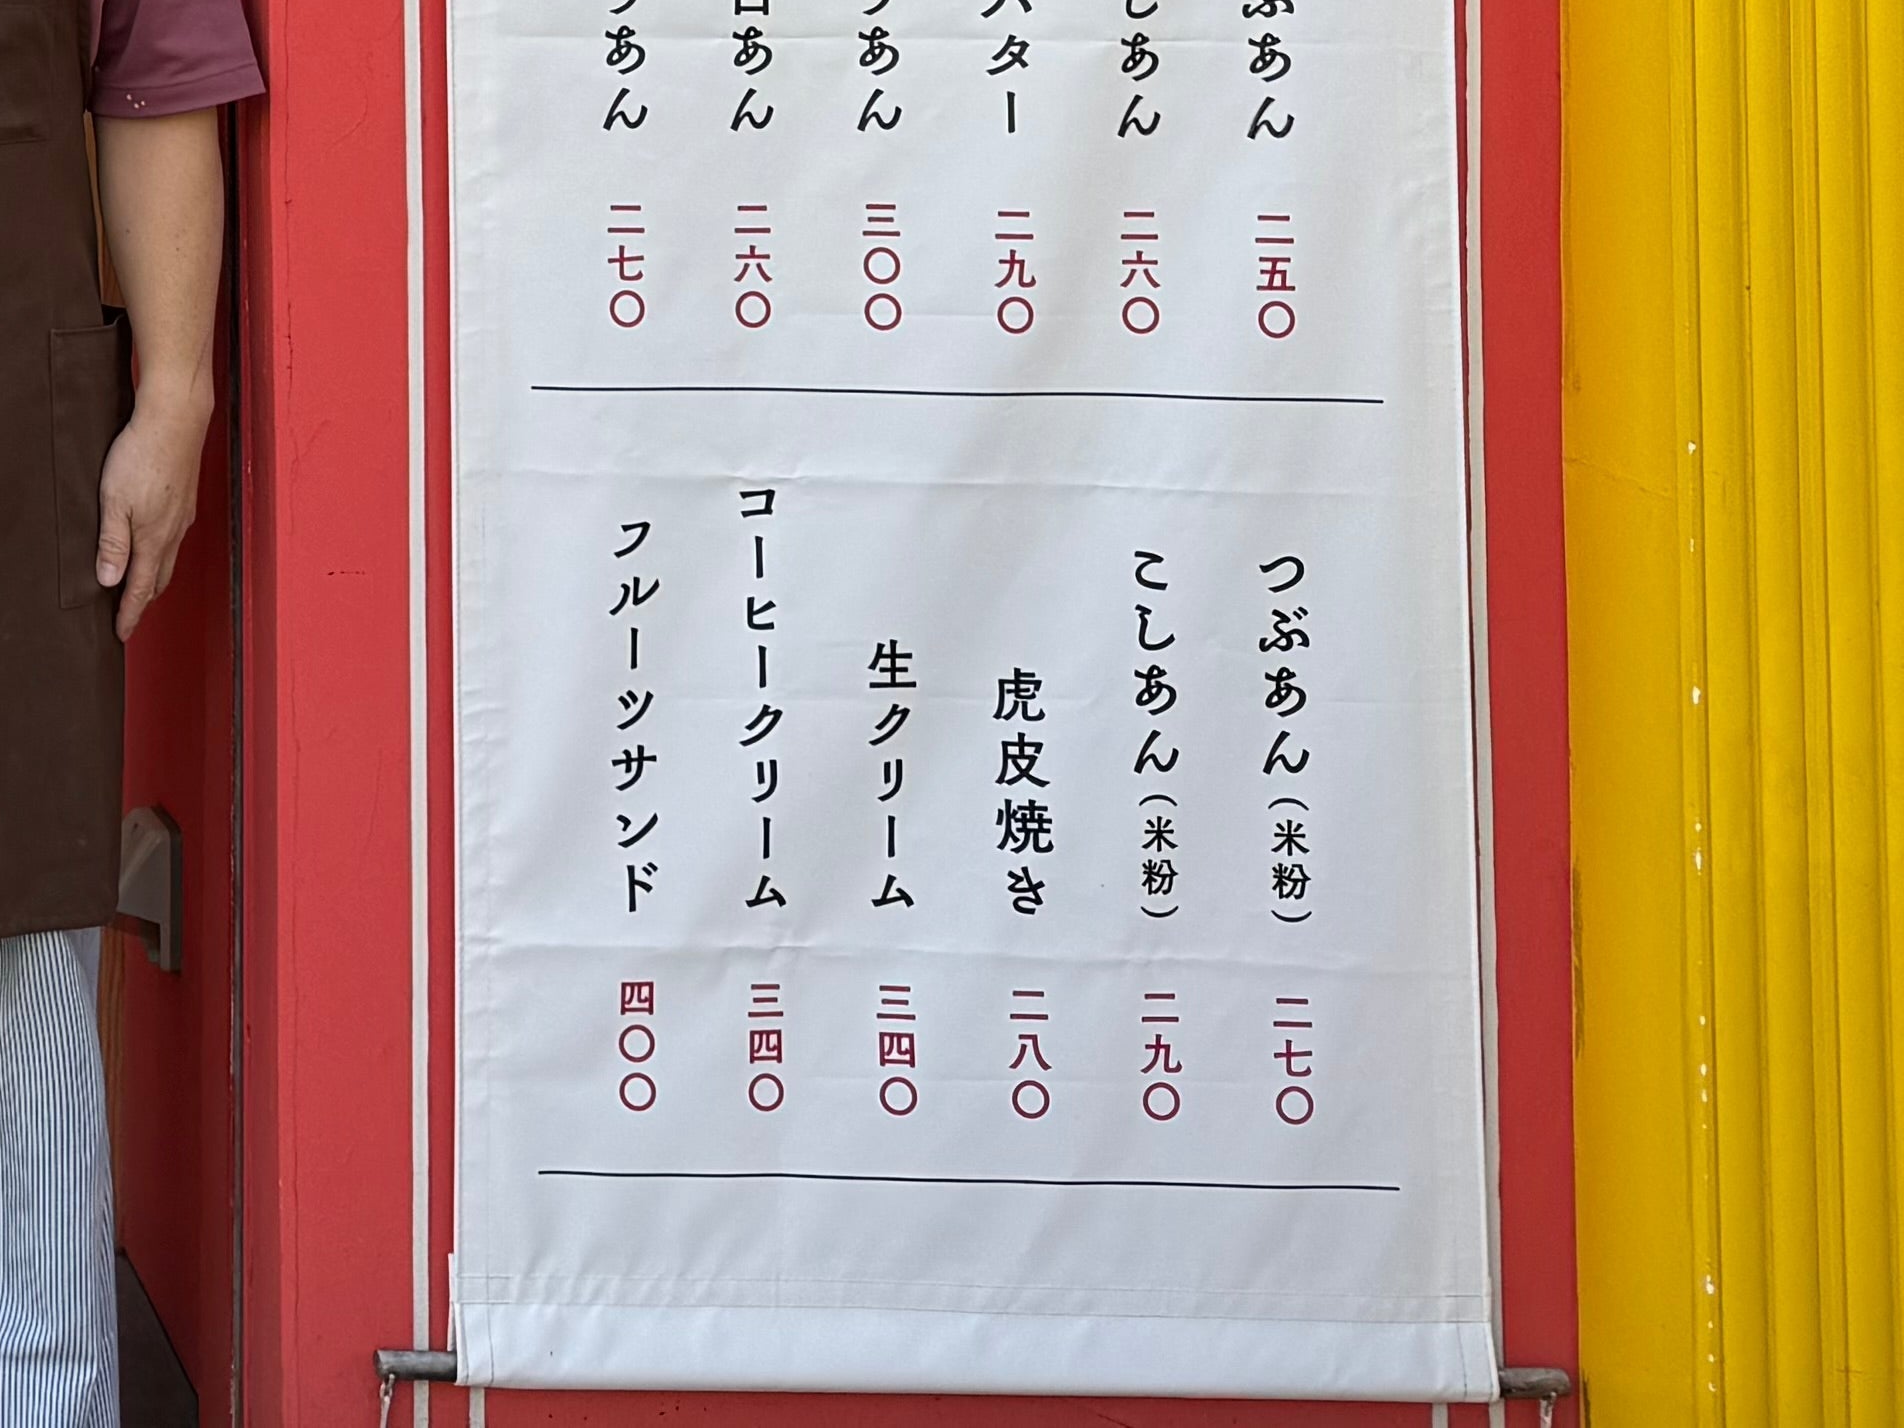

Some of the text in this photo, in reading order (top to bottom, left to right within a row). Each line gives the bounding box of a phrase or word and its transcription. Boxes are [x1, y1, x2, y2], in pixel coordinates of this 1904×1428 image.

[609, 522, 660, 912] フルーツサンド
[739, 489, 786, 908] コーヒークリーム
[868, 639, 916, 907] 生クリーム
[993, 667, 1054, 915] 虎皮焼き
